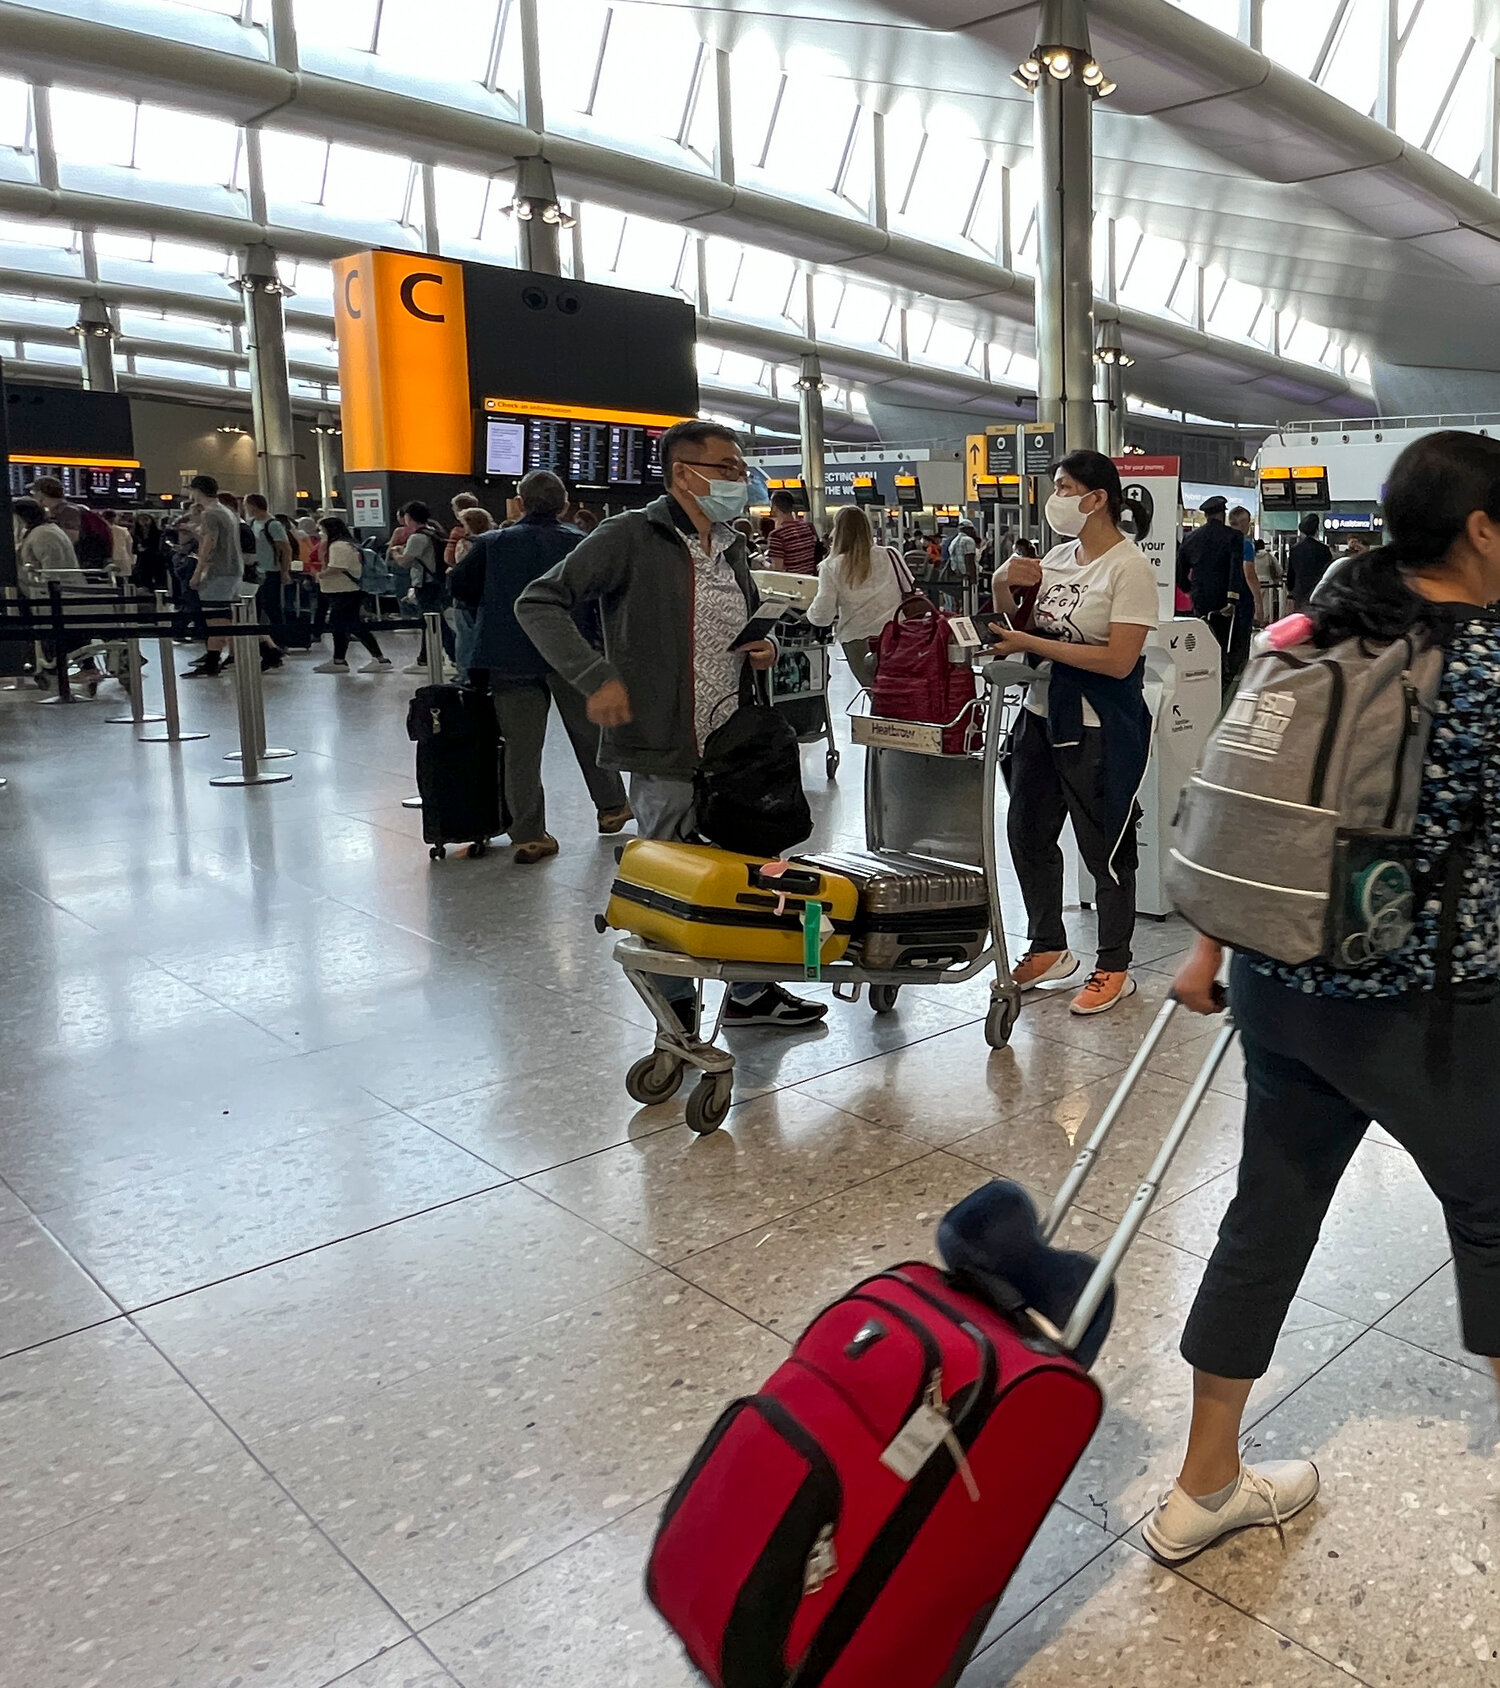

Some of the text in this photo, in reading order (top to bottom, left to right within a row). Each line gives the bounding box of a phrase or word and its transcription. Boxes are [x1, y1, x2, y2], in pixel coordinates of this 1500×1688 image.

[345, 269, 361, 319] C
[400, 272, 445, 323] C
[1141, 542, 1165, 552] your
[871, 722, 916, 740] Heathrow
